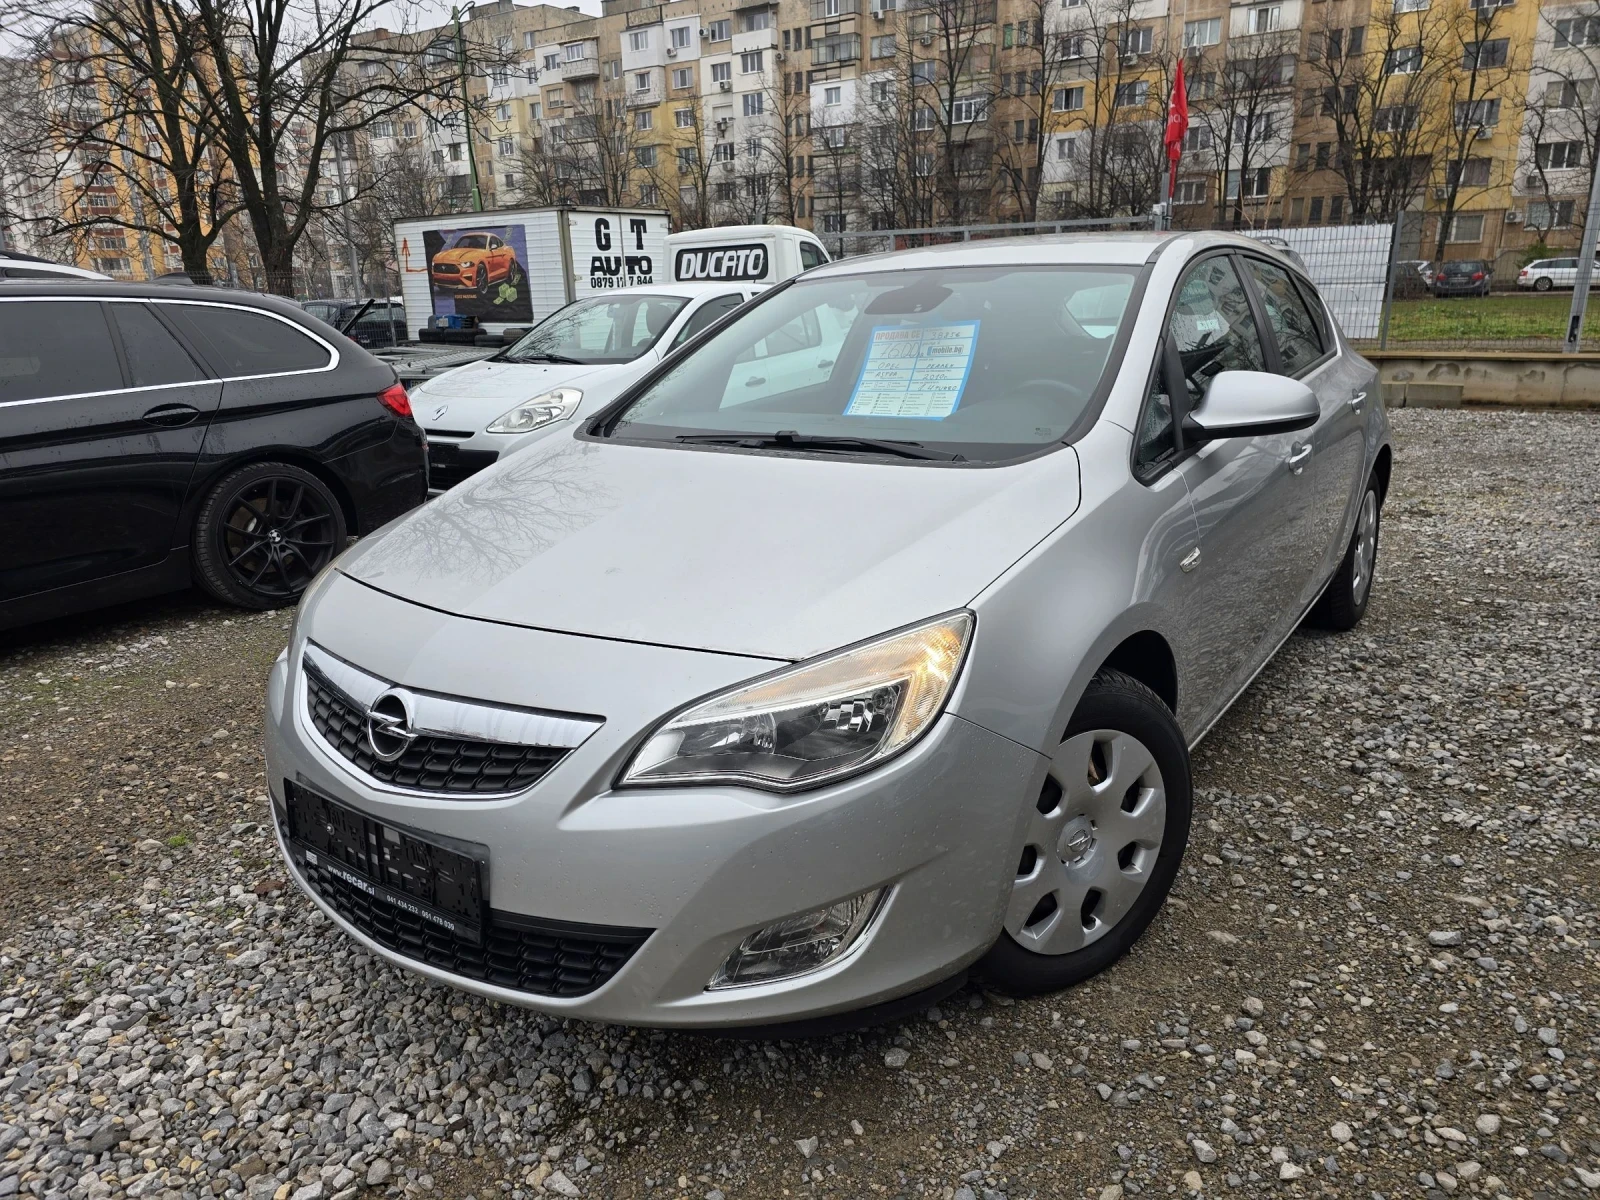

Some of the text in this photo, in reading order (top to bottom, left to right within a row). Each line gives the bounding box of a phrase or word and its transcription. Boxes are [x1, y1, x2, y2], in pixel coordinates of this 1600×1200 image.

[594, 217, 647, 251] G T
[590, 255, 653, 276] AUTO
[680, 249, 763, 279] DUCATO
[590, 277, 614, 288] 0879
[636, 275, 653, 285] 844
[875, 330, 921, 340] ПРОДАВА СЕ
[932, 346, 963, 354] mobile.bg
[327, 864, 375, 896] www.recar.si
[386, 895, 397, 905] 041
[397, 899, 408, 909] 434
[407, 904, 419, 914] 232
